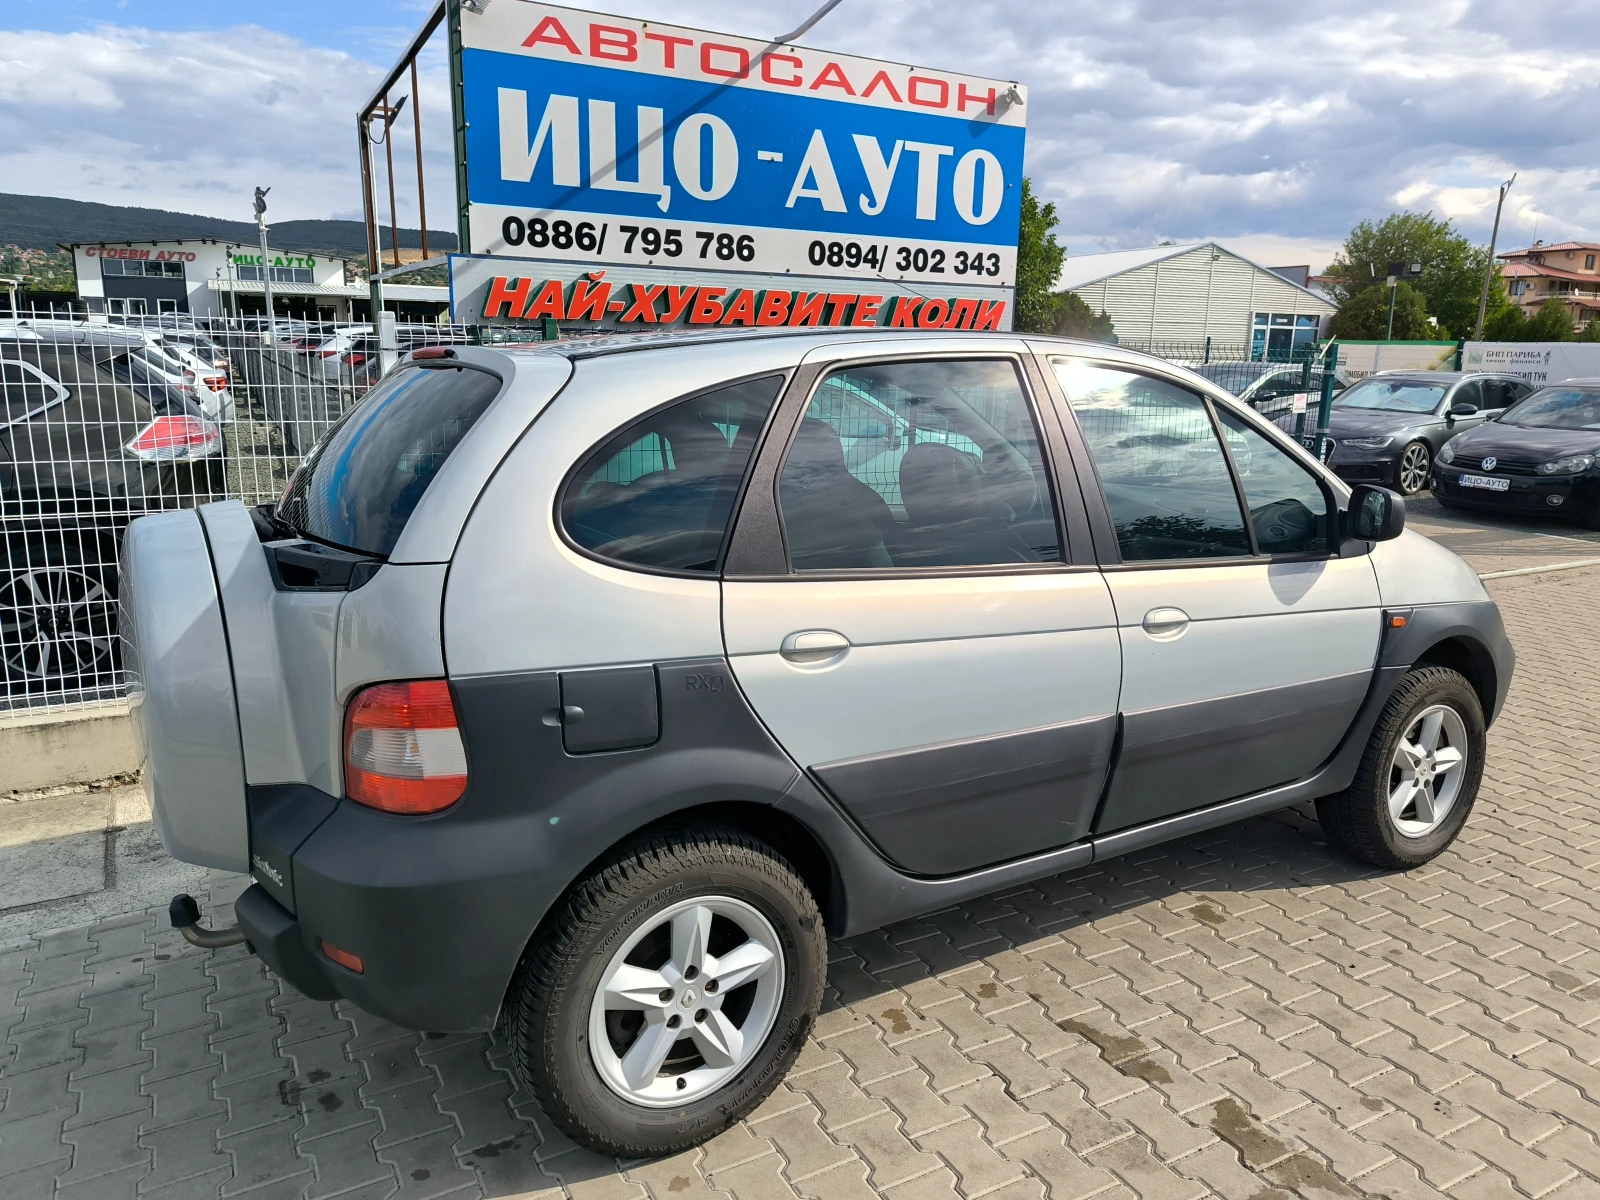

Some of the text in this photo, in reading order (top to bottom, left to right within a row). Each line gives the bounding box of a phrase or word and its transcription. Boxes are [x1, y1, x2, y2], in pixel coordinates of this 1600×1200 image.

[520, 15, 997, 117] АВТОСАЛОН
[85, 246, 196, 262] СТОЕВИ АУТО
[619, 225, 683, 257] 795
[695, 230, 755, 262] 786
[895, 246, 945, 273] 302
[954, 250, 1000, 277] 343
[482, 270, 1006, 331] НАЙ-ХУБАВИТЕ КОЛИ
[1486, 350, 1504, 358] БНП
[1534, 371, 1548, 381] ТУК
[1463, 476, 1509, 489] ИЦО-АУТО
